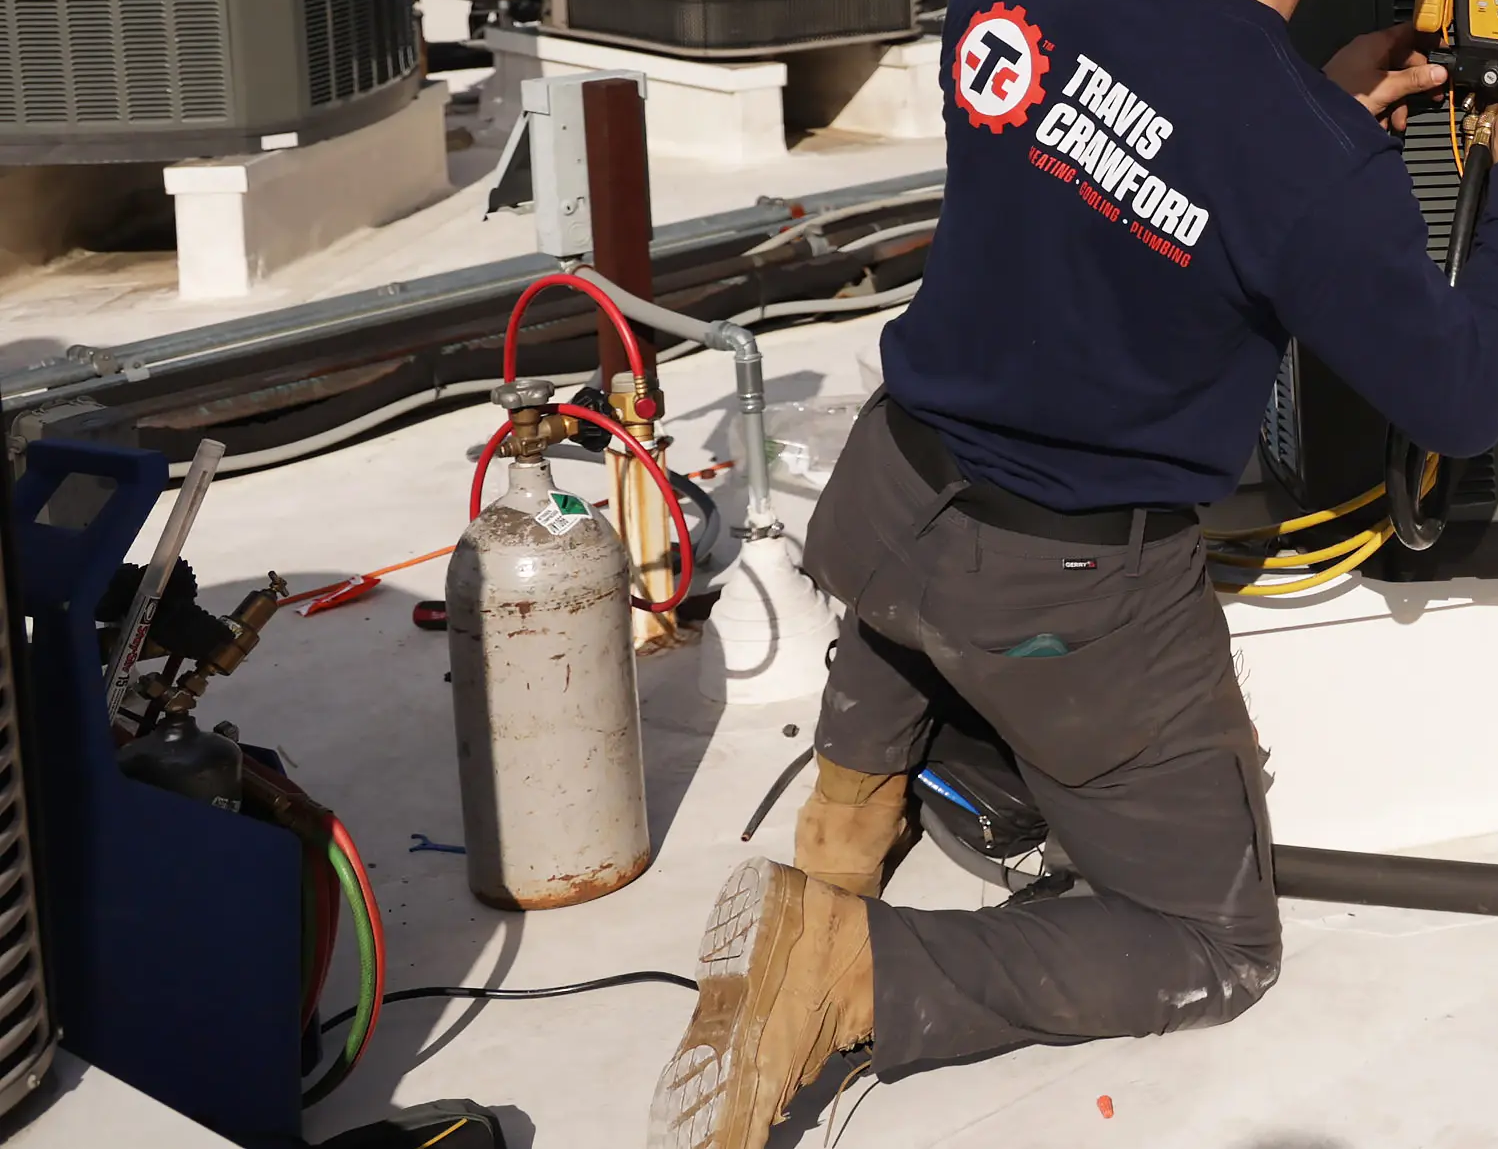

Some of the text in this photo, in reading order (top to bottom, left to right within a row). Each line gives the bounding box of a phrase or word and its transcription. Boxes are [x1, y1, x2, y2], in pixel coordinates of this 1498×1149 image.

[1062, 53, 1174, 160] TRAVIS
[1035, 102, 1209, 247] CRAWFORD
[1079, 181, 1121, 222] COOLING
[1129, 221, 1192, 268] PLUMBING
